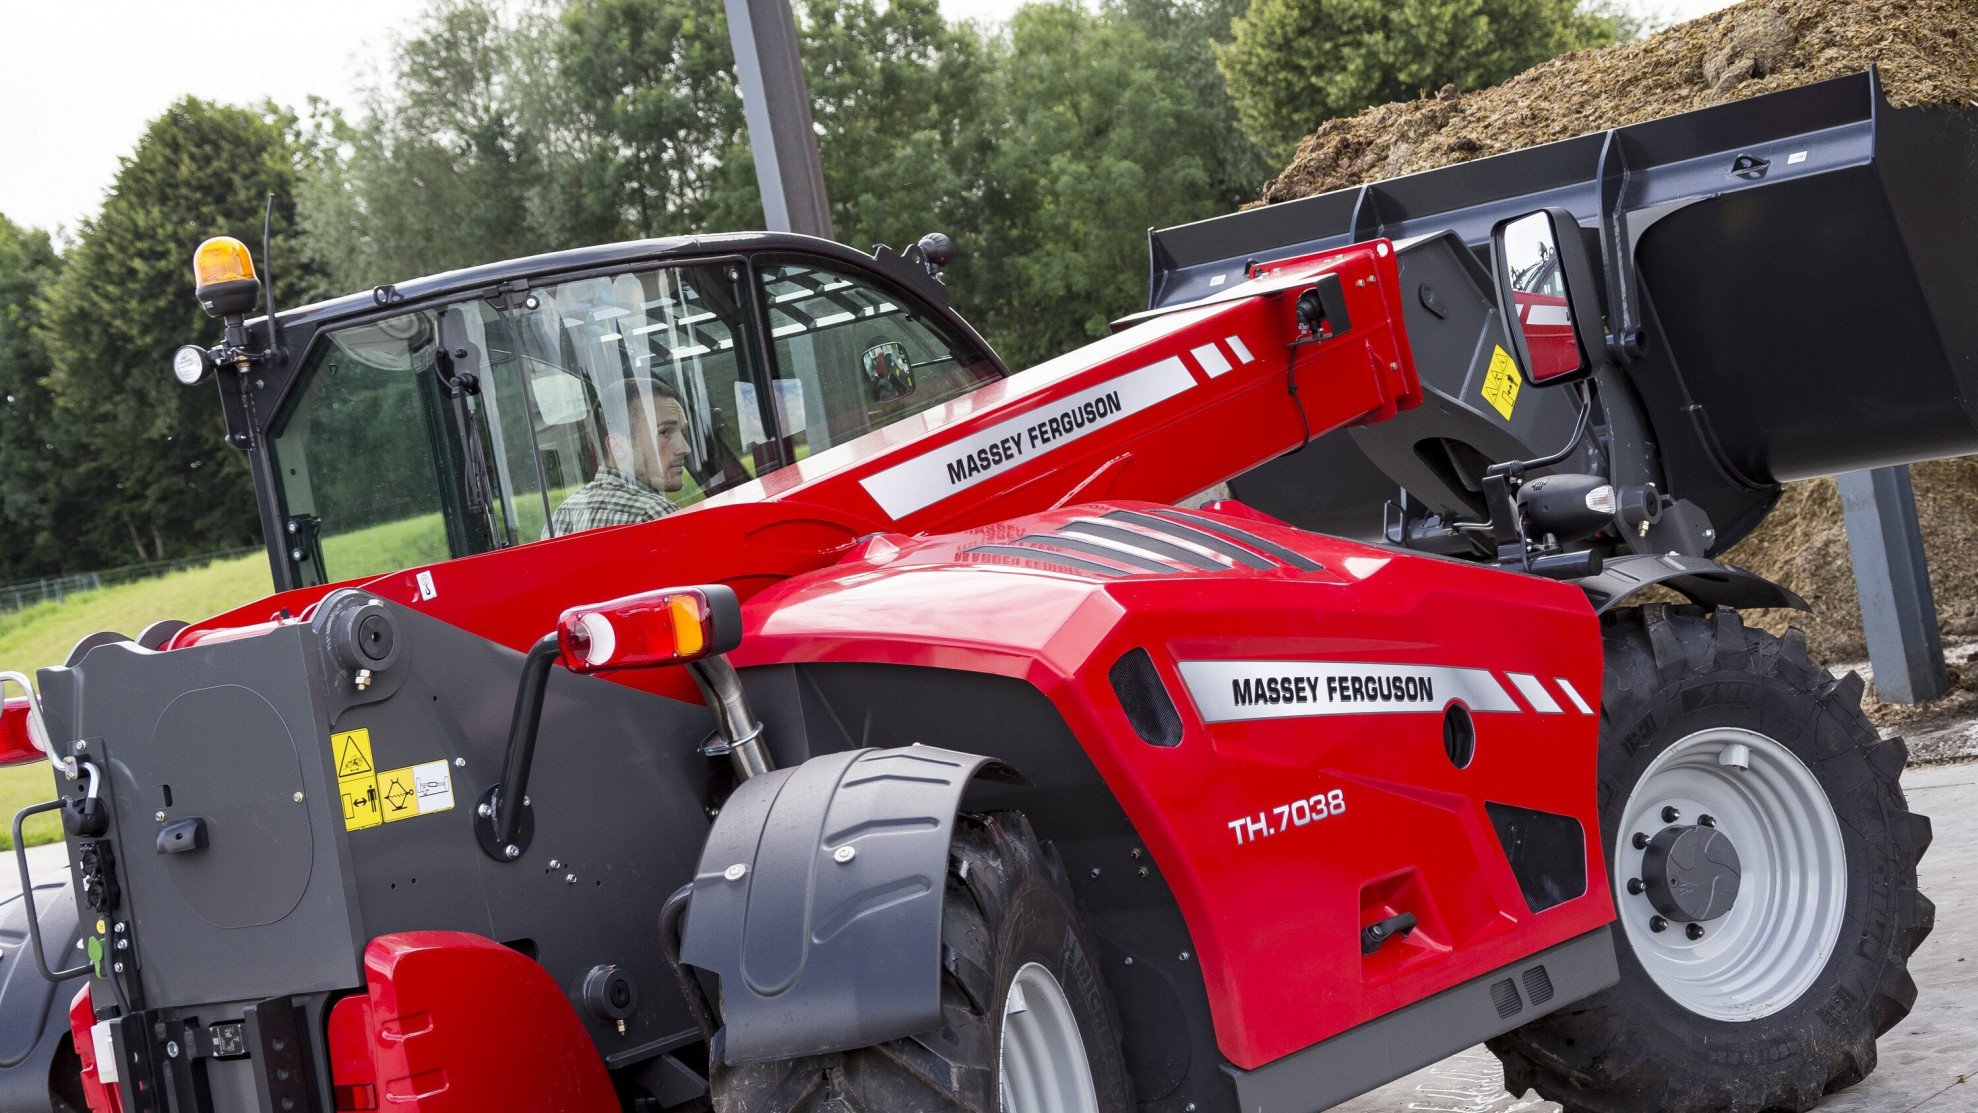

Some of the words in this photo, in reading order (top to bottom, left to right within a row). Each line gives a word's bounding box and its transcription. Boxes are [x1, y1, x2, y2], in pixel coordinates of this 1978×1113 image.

[947, 432, 1023, 485] MASSEY
[1026, 390, 1122, 449] FERGUSON
[1232, 676, 1319, 706] MASSEY
[1326, 675, 1434, 703] FERGUSON
[1228, 788, 1346, 845] TH.7038
